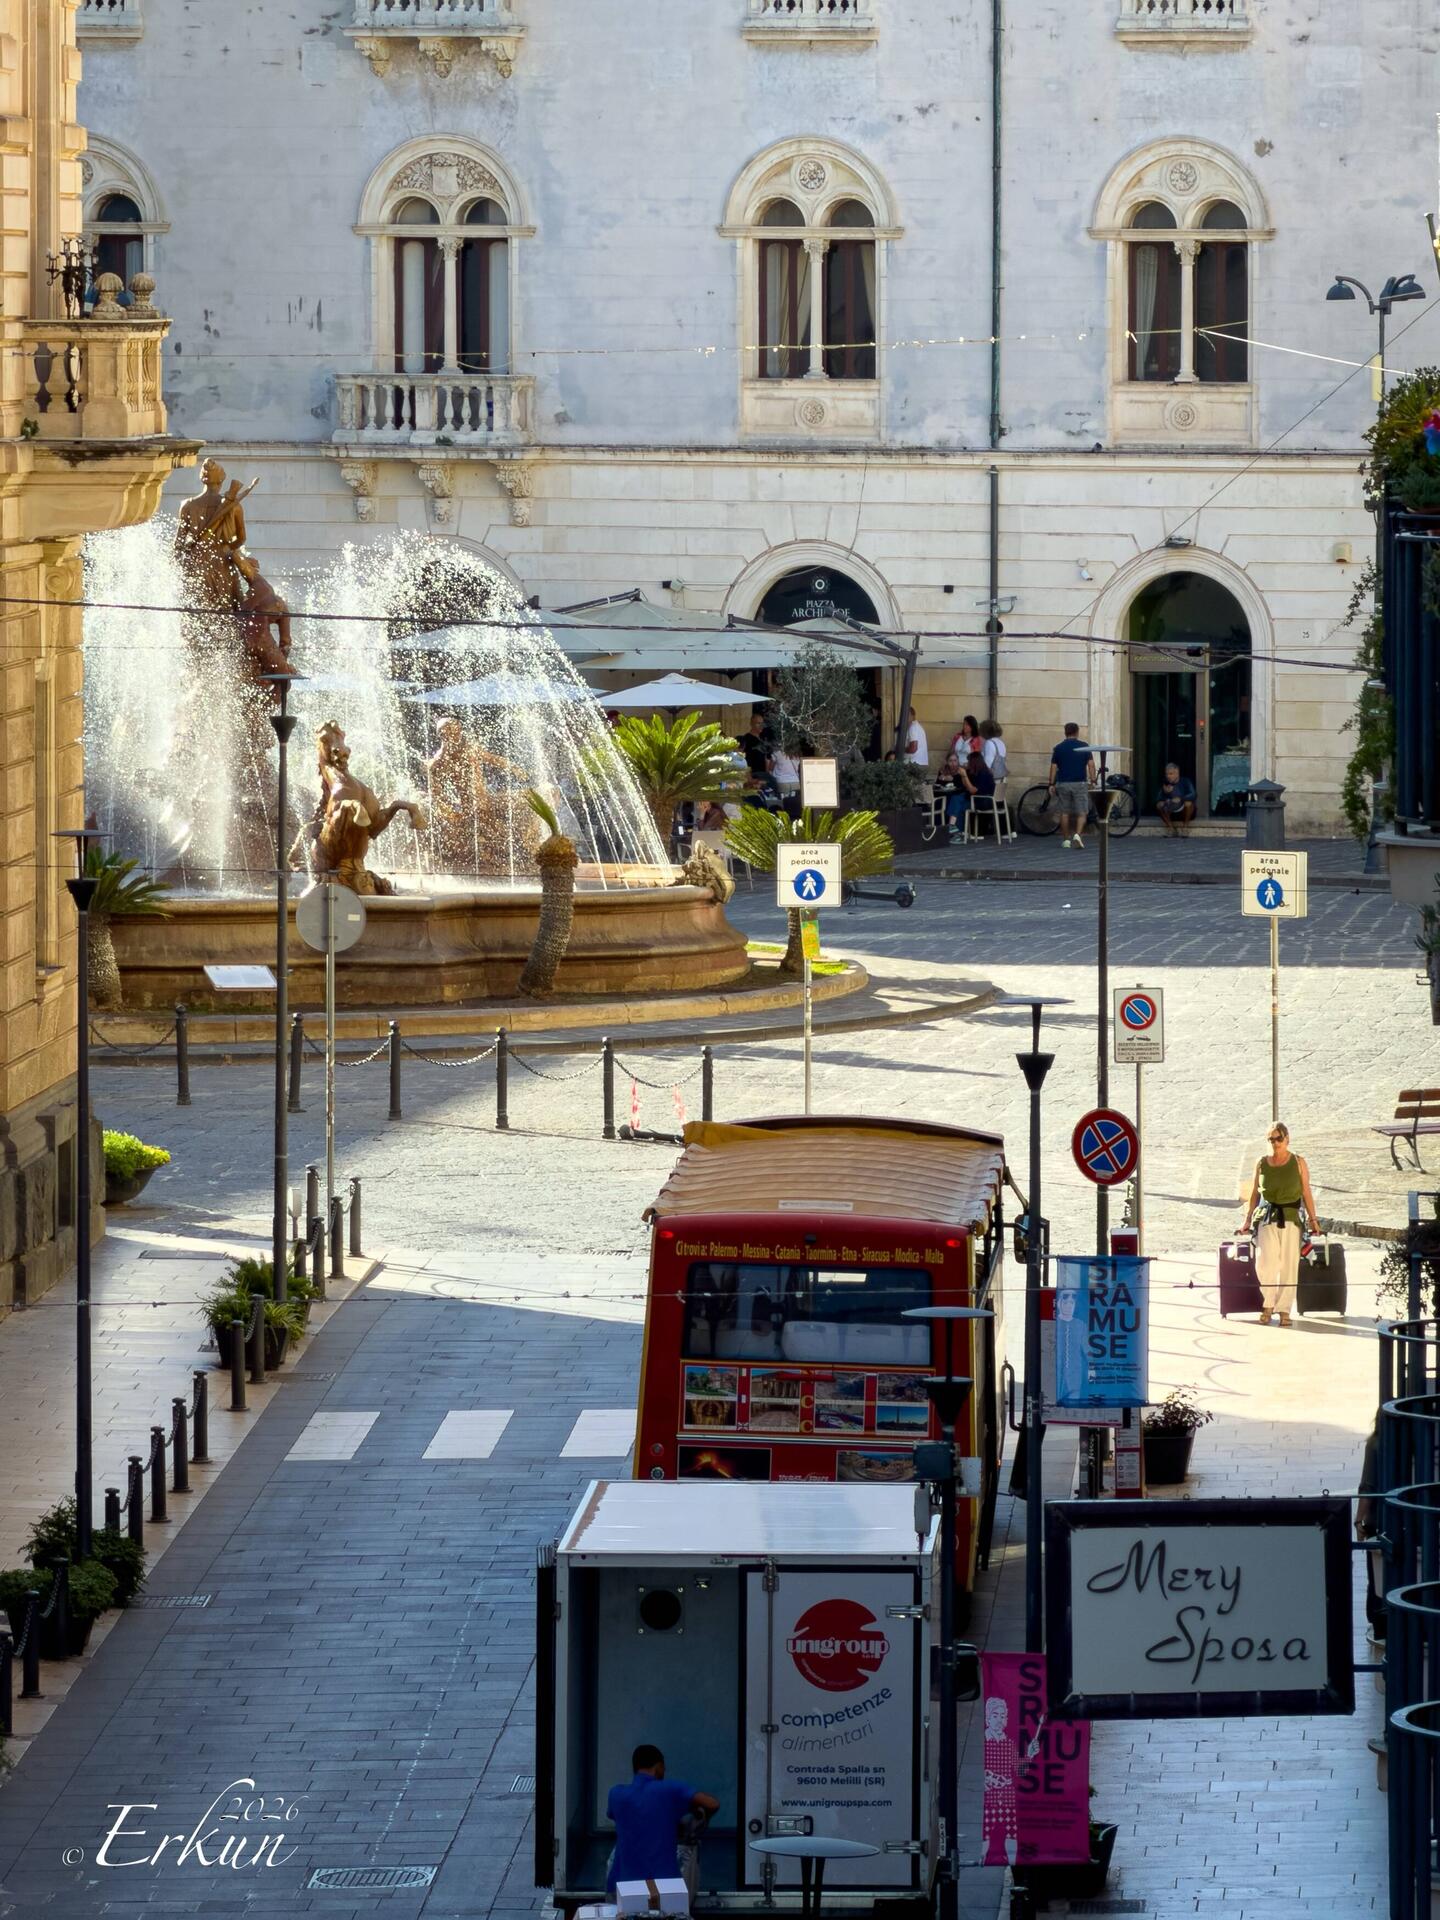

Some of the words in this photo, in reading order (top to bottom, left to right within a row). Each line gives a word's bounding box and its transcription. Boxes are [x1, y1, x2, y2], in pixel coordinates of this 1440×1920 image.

[790, 858, 829, 866] pedonale
[1250, 867, 1290, 875] pedonale
[710, 1242, 738, 1258] Palermo
[743, 1243, 770, 1259] Messina
[775, 1244, 801, 1260] Catania
[805, 1245, 837, 1261] Taormina
[842, 1246, 858, 1261] Etna
[862, 1247, 890, 1262] Siracusa
[895, 1248, 920, 1263] Modica
[925, 1248, 944, 1264] Malta
[1089, 1283, 1135, 1307] RA
[1088, 1308, 1142, 1333] MU
[1088, 1334, 1128, 1359] SE
[1087, 1540, 1242, 1616] Mery
[786, 1637, 889, 1659] unigroup
[1145, 1606, 1311, 1685] Sposa
[1018, 1661, 1042, 1693] S
[781, 1688, 893, 1728] competenze
[782, 1720, 874, 1751] alimentari
[1018, 1729, 1082, 1761] MU
[786, 1764, 836, 1774] Contrada
[838, 1764, 870, 1775] Spalla
[797, 1776, 827, 1785] 96010
[830, 1776, 861, 1785] Melilli
[864, 1776, 885, 1787] (SR)
[1018, 1763, 1065, 1794] SE
[781, 1798, 892, 1809] www.unigroupspa.com
